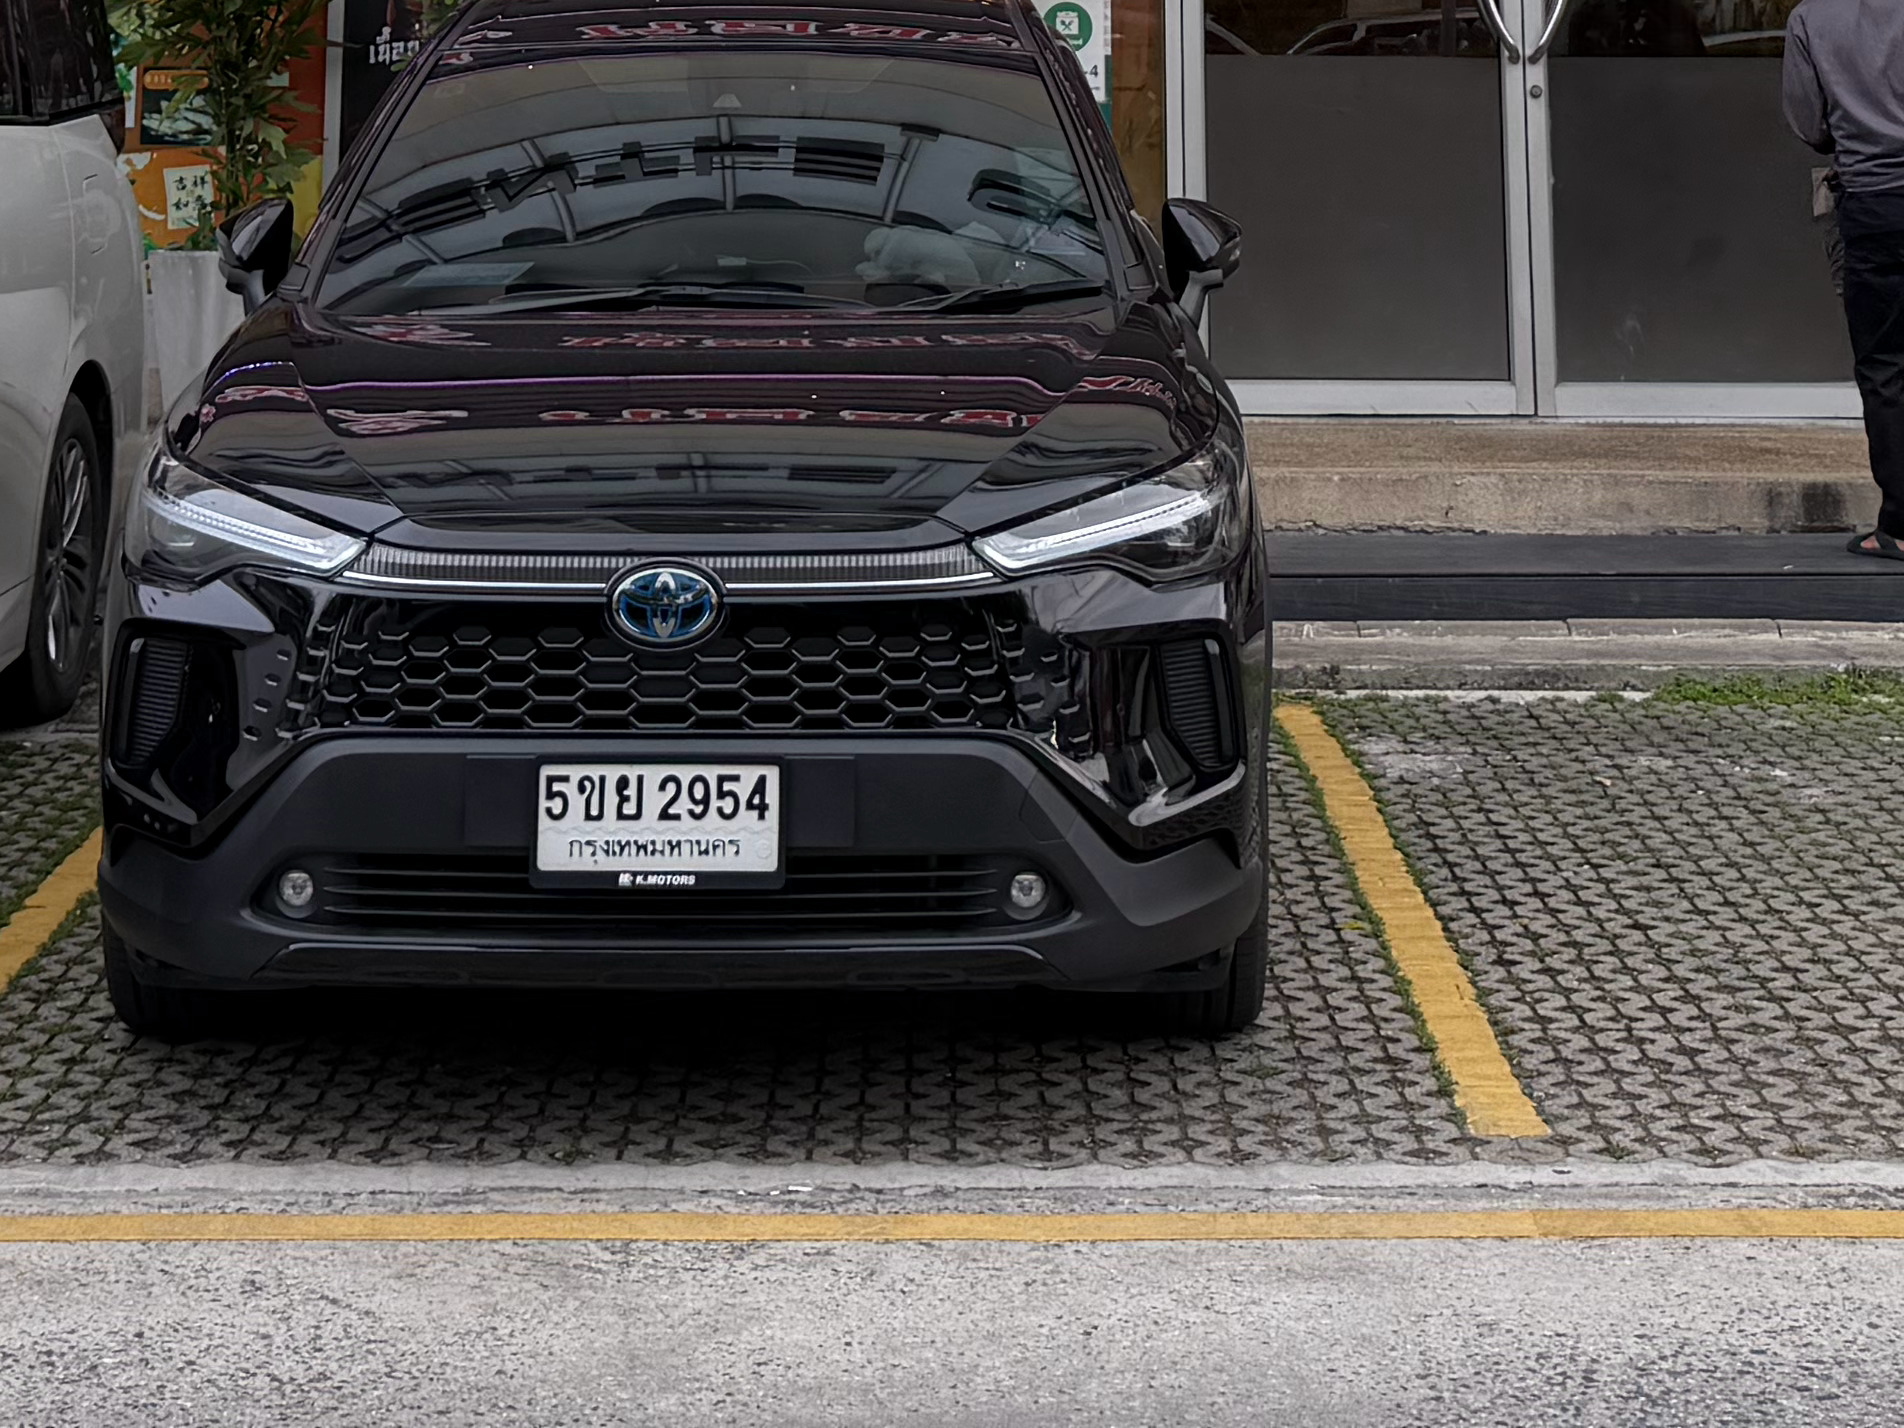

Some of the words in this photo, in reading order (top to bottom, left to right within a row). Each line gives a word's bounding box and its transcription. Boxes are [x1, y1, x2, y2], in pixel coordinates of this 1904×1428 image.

[544, 773, 645, 822] 5ขย
[656, 773, 770, 822] 2954
[568, 837, 741, 865] กรุงเทพมหานคร
[635, 874, 697, 886] K.MOTORS
